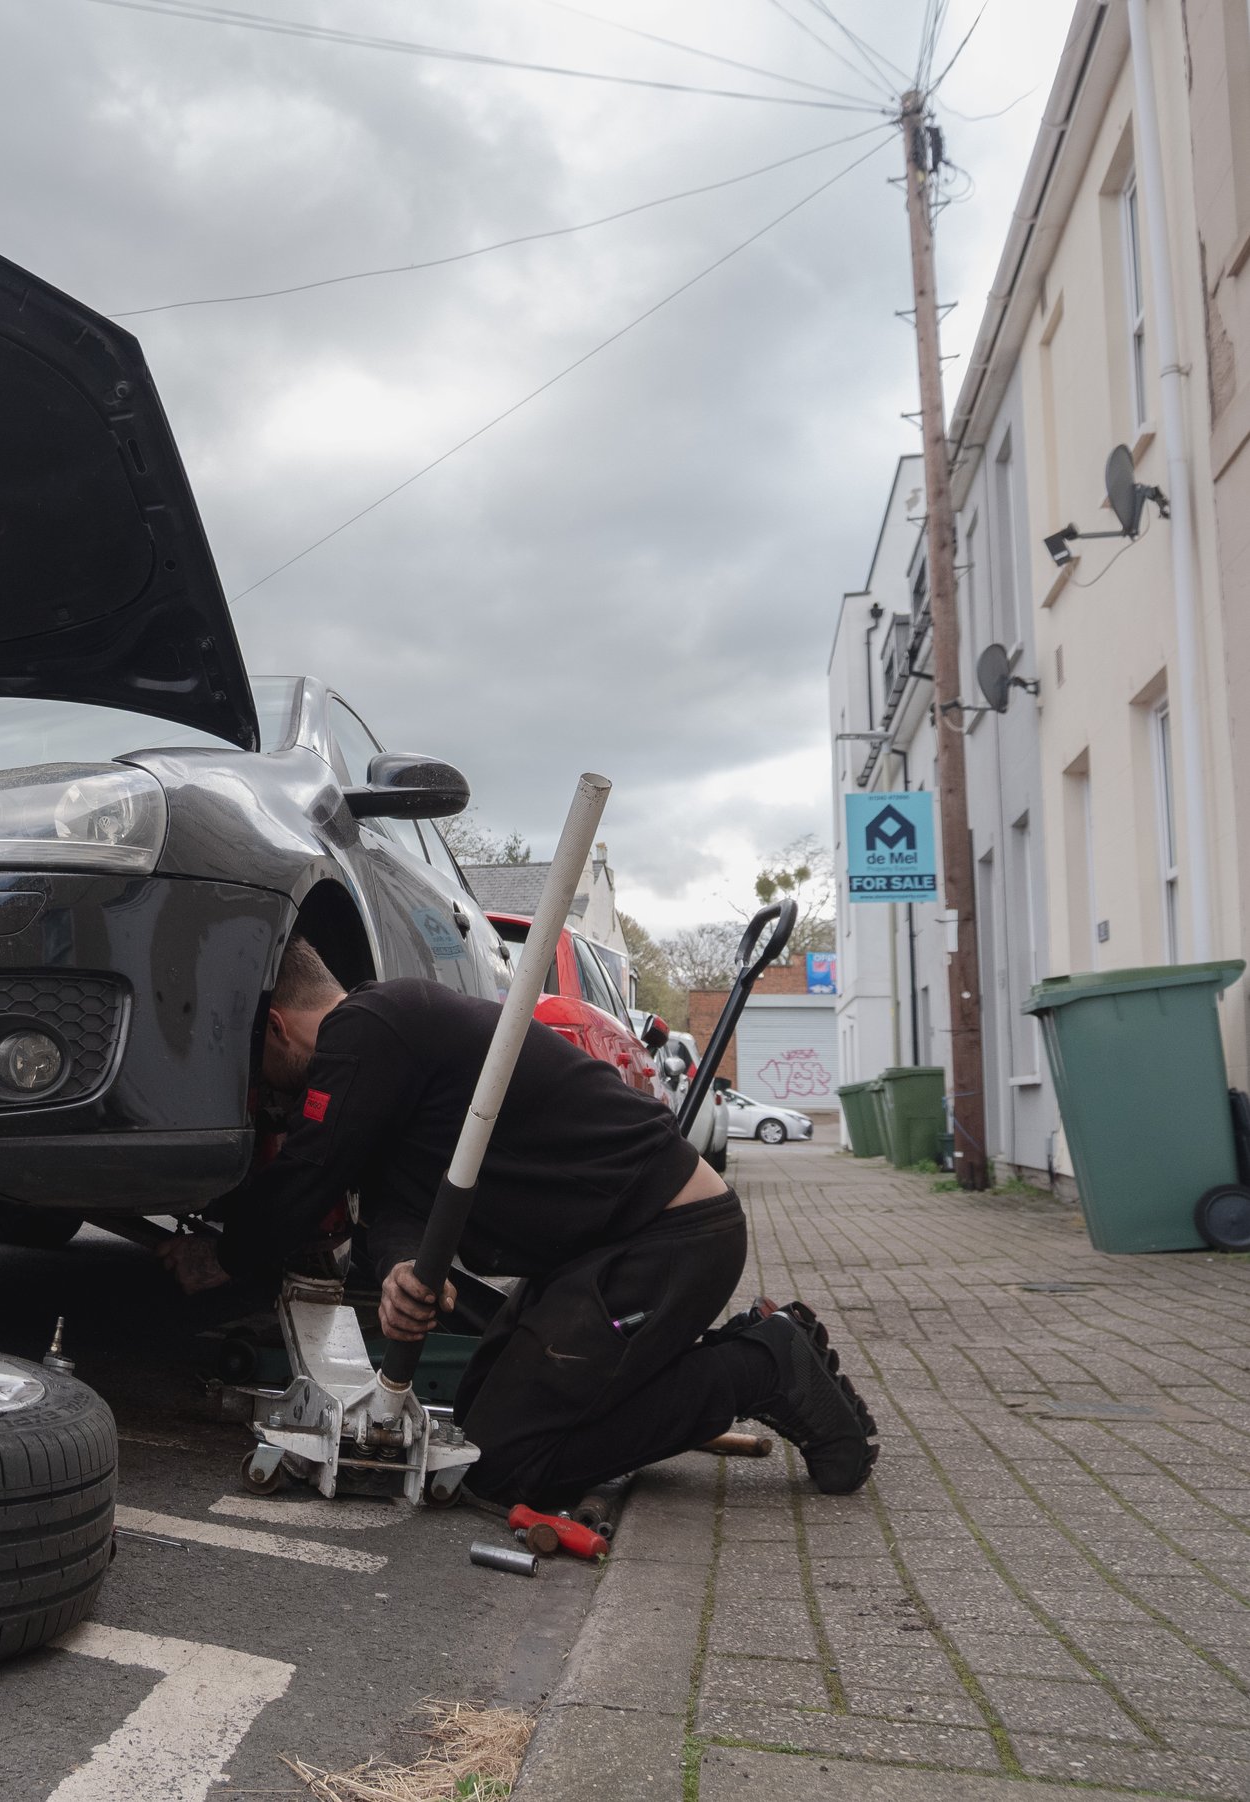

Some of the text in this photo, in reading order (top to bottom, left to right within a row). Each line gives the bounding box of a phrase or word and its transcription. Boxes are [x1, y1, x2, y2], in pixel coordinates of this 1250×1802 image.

[866, 851, 918, 864] de Mel
[851, 876, 934, 891] FOR SALE
